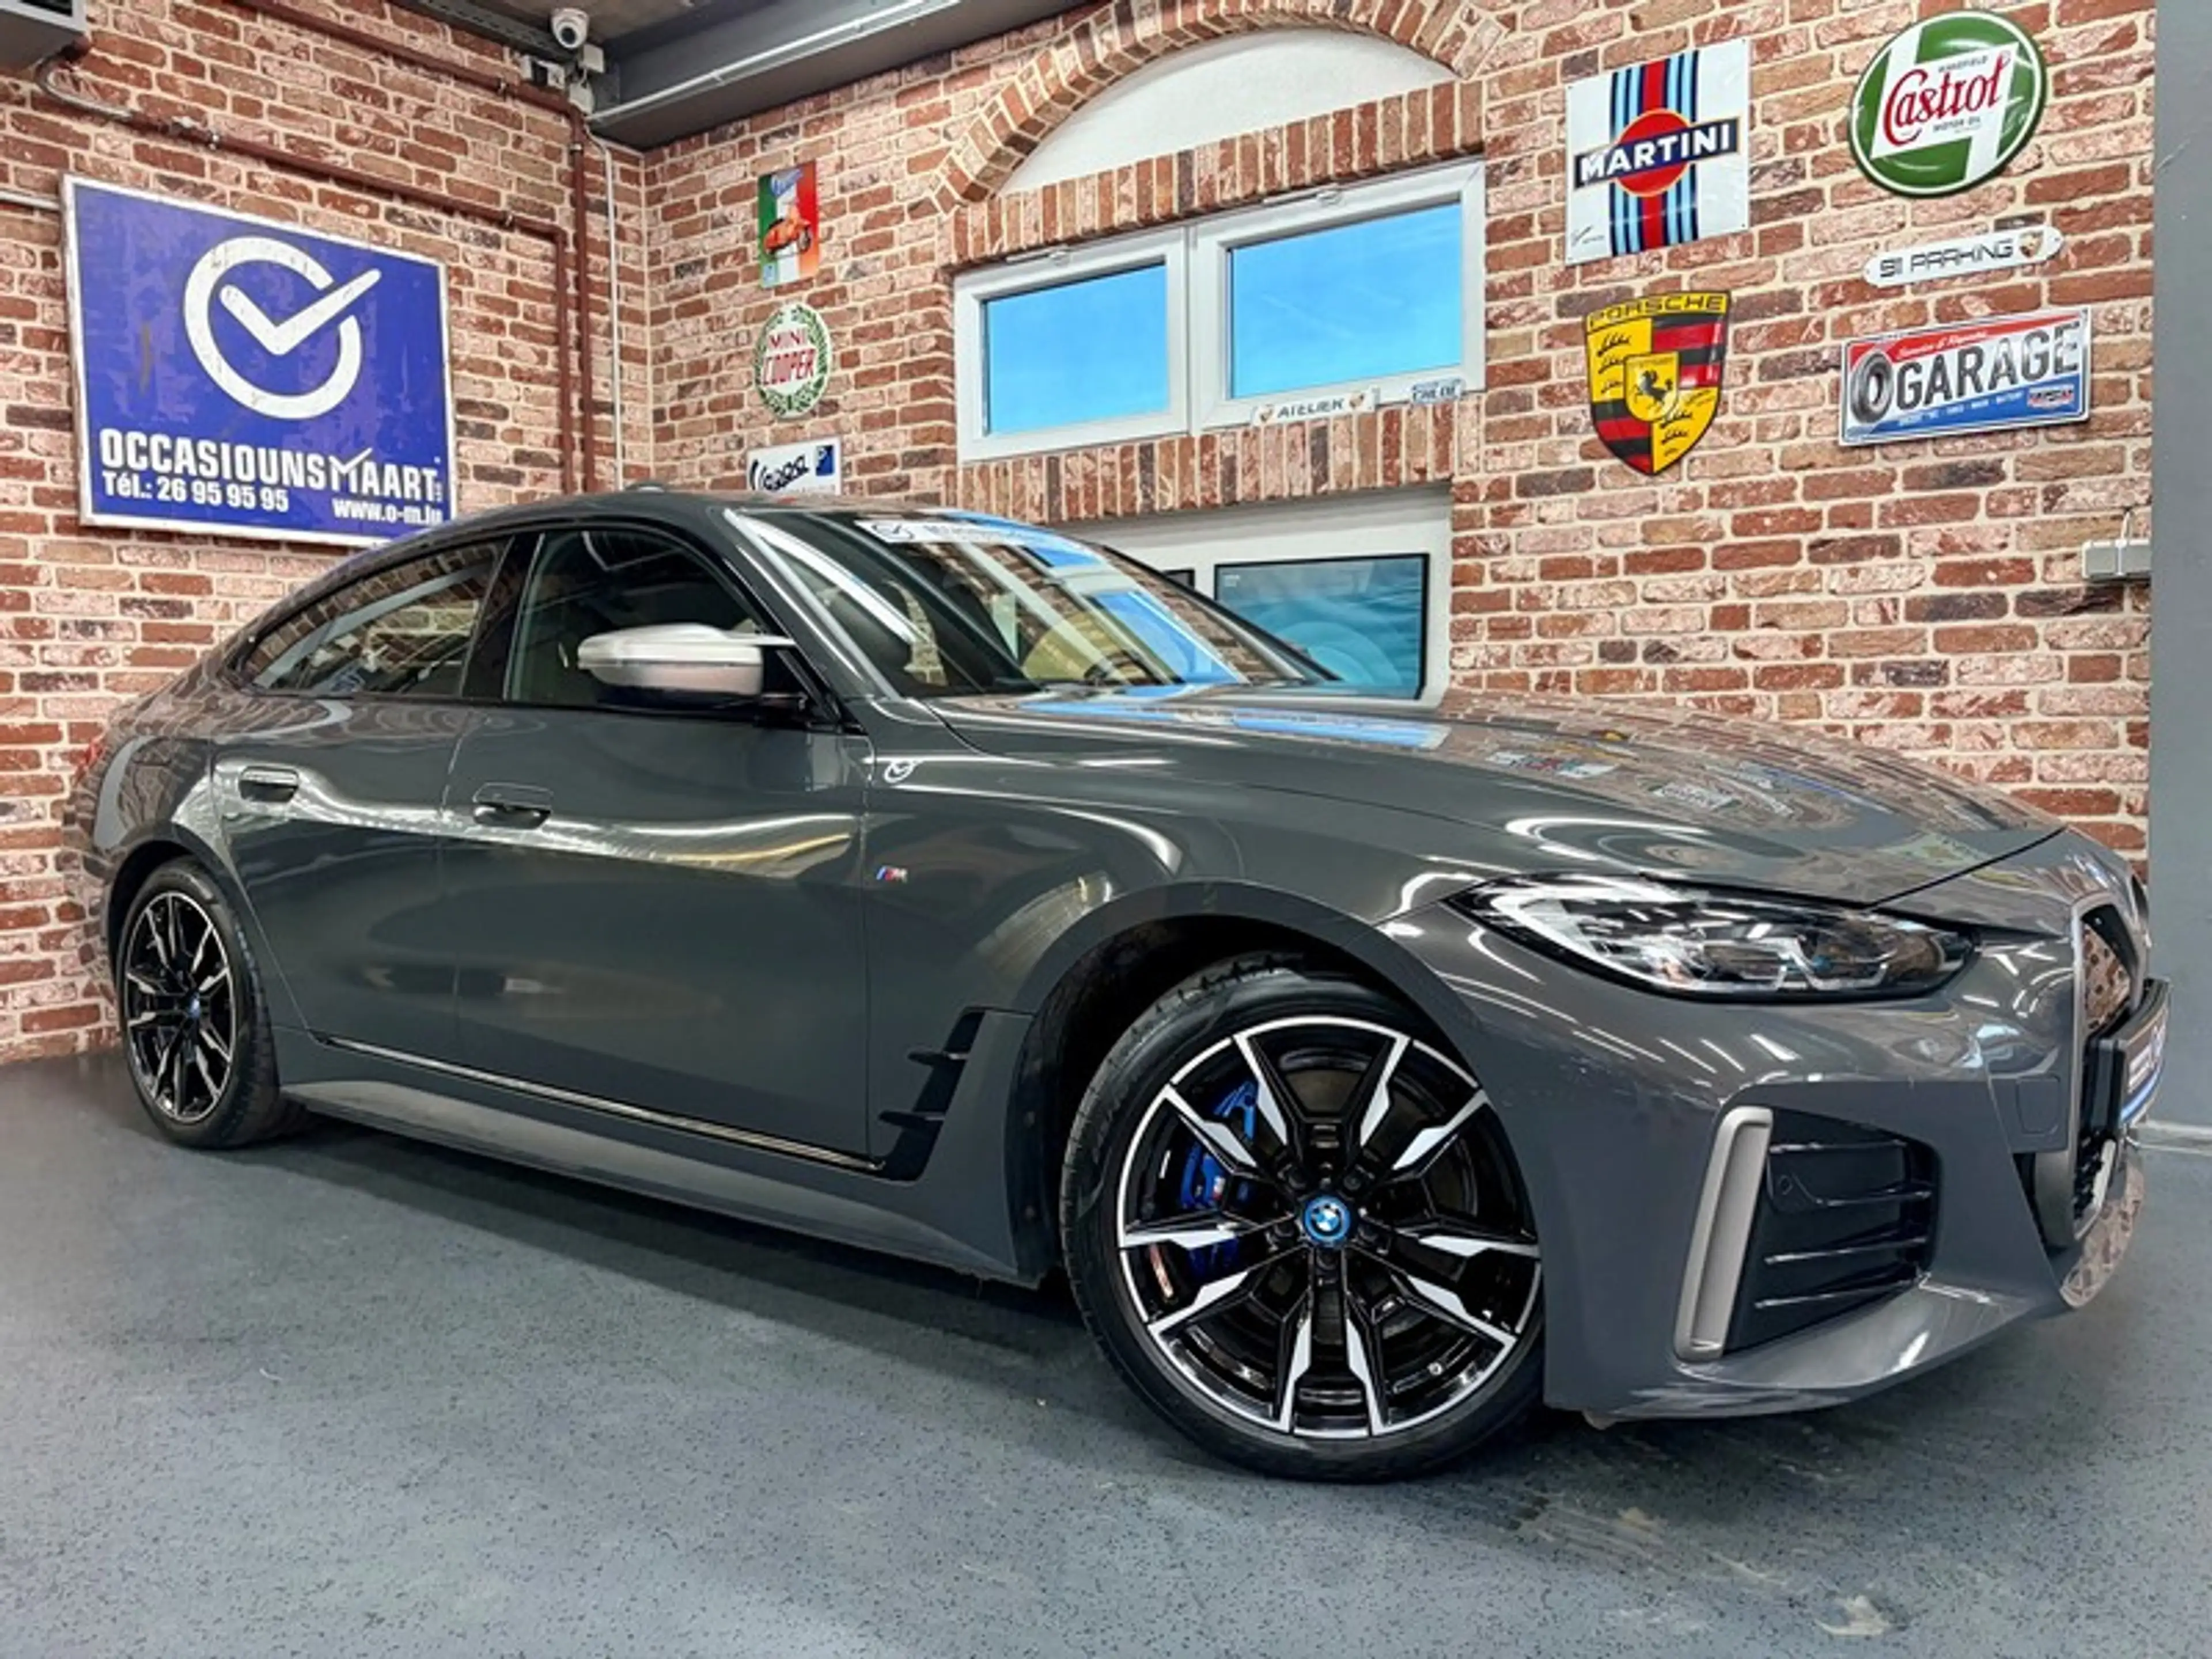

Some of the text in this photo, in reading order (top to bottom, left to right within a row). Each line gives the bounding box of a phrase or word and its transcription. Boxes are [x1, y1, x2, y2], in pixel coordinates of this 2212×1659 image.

[1883, 51, 2010, 146] Castrol
[1581, 124, 1729, 181] MARTINI
[1589, 294, 1724, 328] PORSCHE
[763, 349, 815, 385] COOPER
[1897, 320, 2080, 410] GARAGE
[99, 428, 438, 502] OCCASIOUNSMAART
[157, 476, 186, 503] 26
[191, 479, 222, 506] 95
[226, 483, 256, 509] 95
[260, 487, 289, 513] 95
